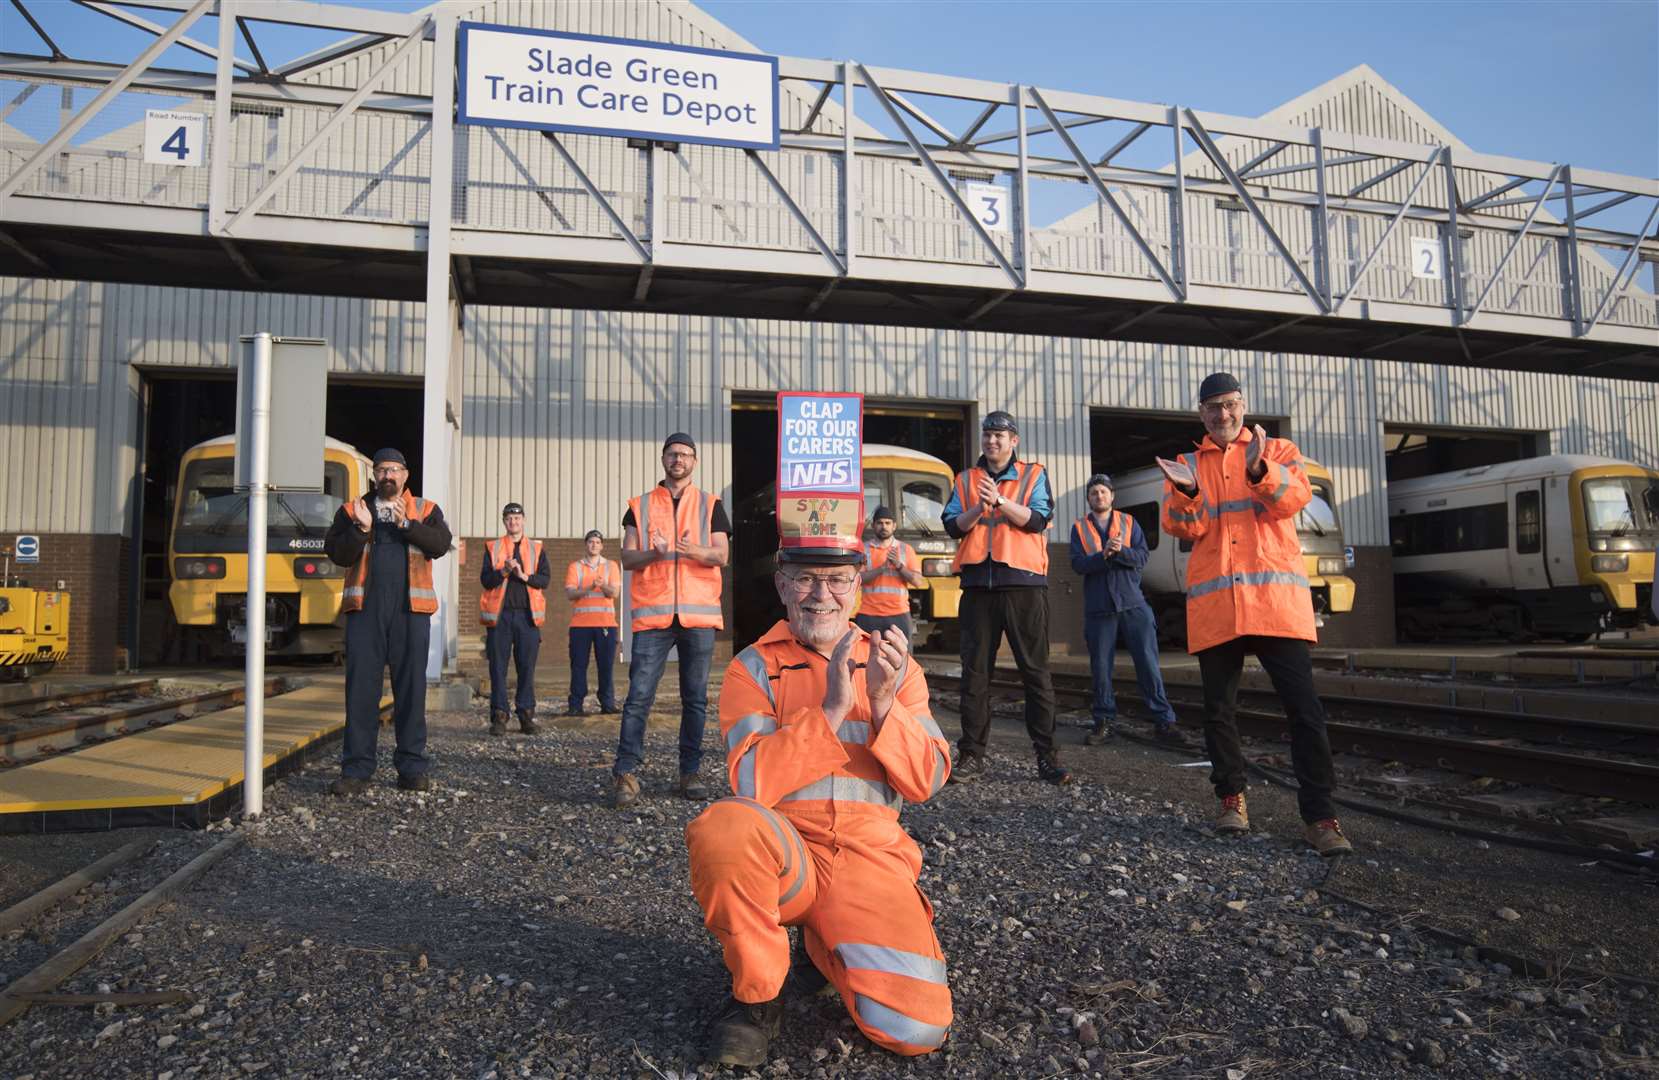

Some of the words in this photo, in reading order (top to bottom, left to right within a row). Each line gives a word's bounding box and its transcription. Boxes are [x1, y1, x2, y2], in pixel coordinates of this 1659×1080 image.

[528, 47, 612, 79] Slade
[626, 58, 717, 90] Green
[484, 75, 563, 105] Train
[577, 84, 648, 113] Care
[663, 92, 757, 126] Depot
[149, 111, 168, 119] Road
[161, 126, 189, 160] 4
[982, 196, 999, 226] 3
[1421, 249, 1434, 274] 2
[800, 400, 844, 419] CLAP
[785, 419, 818, 436] FOR
[822, 420, 857, 437] OUR
[787, 436, 855, 455] CARERS
[791, 461, 849, 487] NHS
[796, 498, 839, 512] STAY
[808, 510, 827, 522] AT
[800, 522, 837, 536] HOME
[288, 539, 326, 549] 465037
